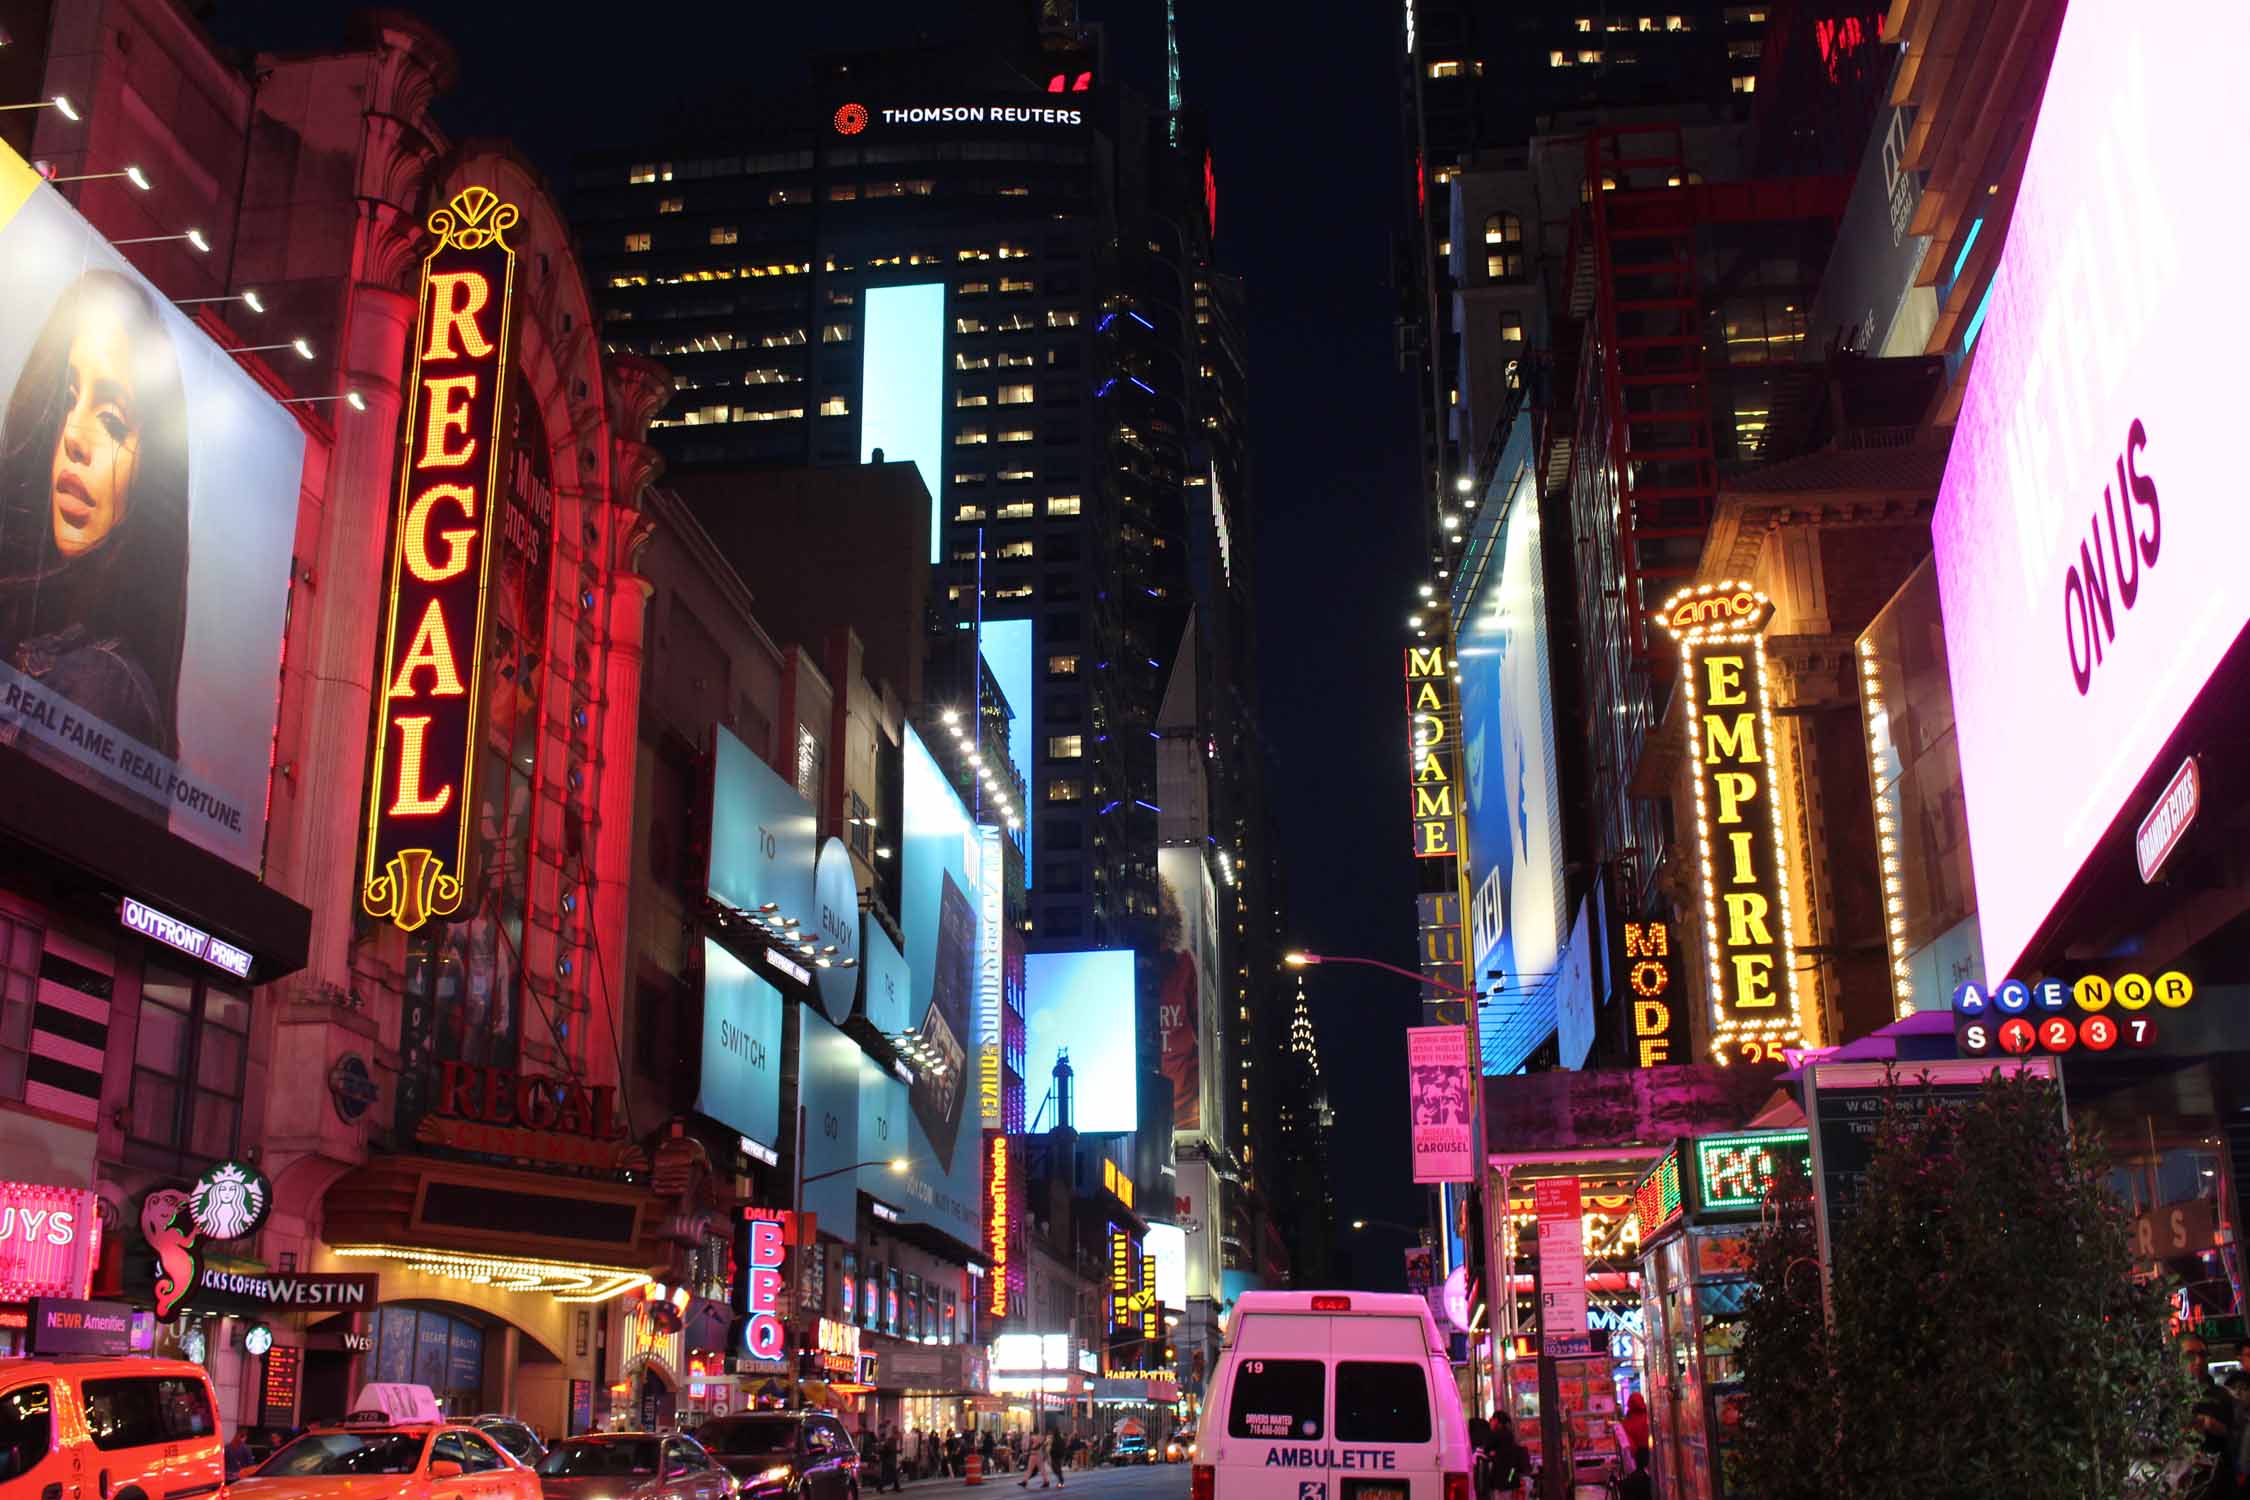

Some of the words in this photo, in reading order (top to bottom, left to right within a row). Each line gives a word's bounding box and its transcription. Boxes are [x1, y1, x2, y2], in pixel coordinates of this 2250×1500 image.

[882, 107, 984, 123] THOMSON
[990, 107, 1082, 125] REUTERS
[388, 270, 494, 818] REGAL
[2064, 537, 2116, 697] ON
[2104, 417, 2161, 610] US
[1672, 592, 1754, 626] amc
[6, 683, 56, 731] REAL
[59, 714, 116, 765] FAME.
[119, 748, 163, 791] REAL
[165, 773, 242, 833] FORTUNE.
[1408, 646, 1453, 854] MADAME
[2168, 767, 2194, 832] CITIES
[758, 823, 776, 859] TO
[1704, 656, 1777, 1008] EMPIRE
[126, 902, 206, 954] OUTFRONT
[210, 942, 249, 974] PRIME
[822, 903, 853, 947] ENJOY
[1962, 991, 1983, 1008] A
[2003, 991, 2023, 1008] C
[2044, 983, 2063, 1006] E
[2084, 983, 2104, 1002] N
[2124, 981, 2145, 1001] Q
[2166, 979, 2186, 999] R
[720, 1018, 766, 1072] SWITCH
[1967, 1025, 1987, 1049] S
[2009, 1024, 2023, 1046] 1
[2049, 1023, 2067, 1044] 2
[2090, 1021, 2108, 1043] 3
[2131, 1020, 2147, 1042] 7
[435, 1060, 630, 1142] REGAL
[824, 1111, 838, 1141] GO
[877, 1116, 888, 1141] TO
[1416, 1142, 1469, 1153] CAROUSEL
[989, 1137, 1007, 1196] Theatre
[1113, 1232, 1127, 1291] VICTORY
[229, 1276, 268, 1299] COFFEE
[265, 1279, 364, 1304] WESTIN
[745, 1220, 787, 1362] BBQ
[1104, 1368, 1138, 1380] HARRY
[1245, 1361, 1264, 1374] 19
[1265, 1447, 1397, 1469] AMBULETTE
